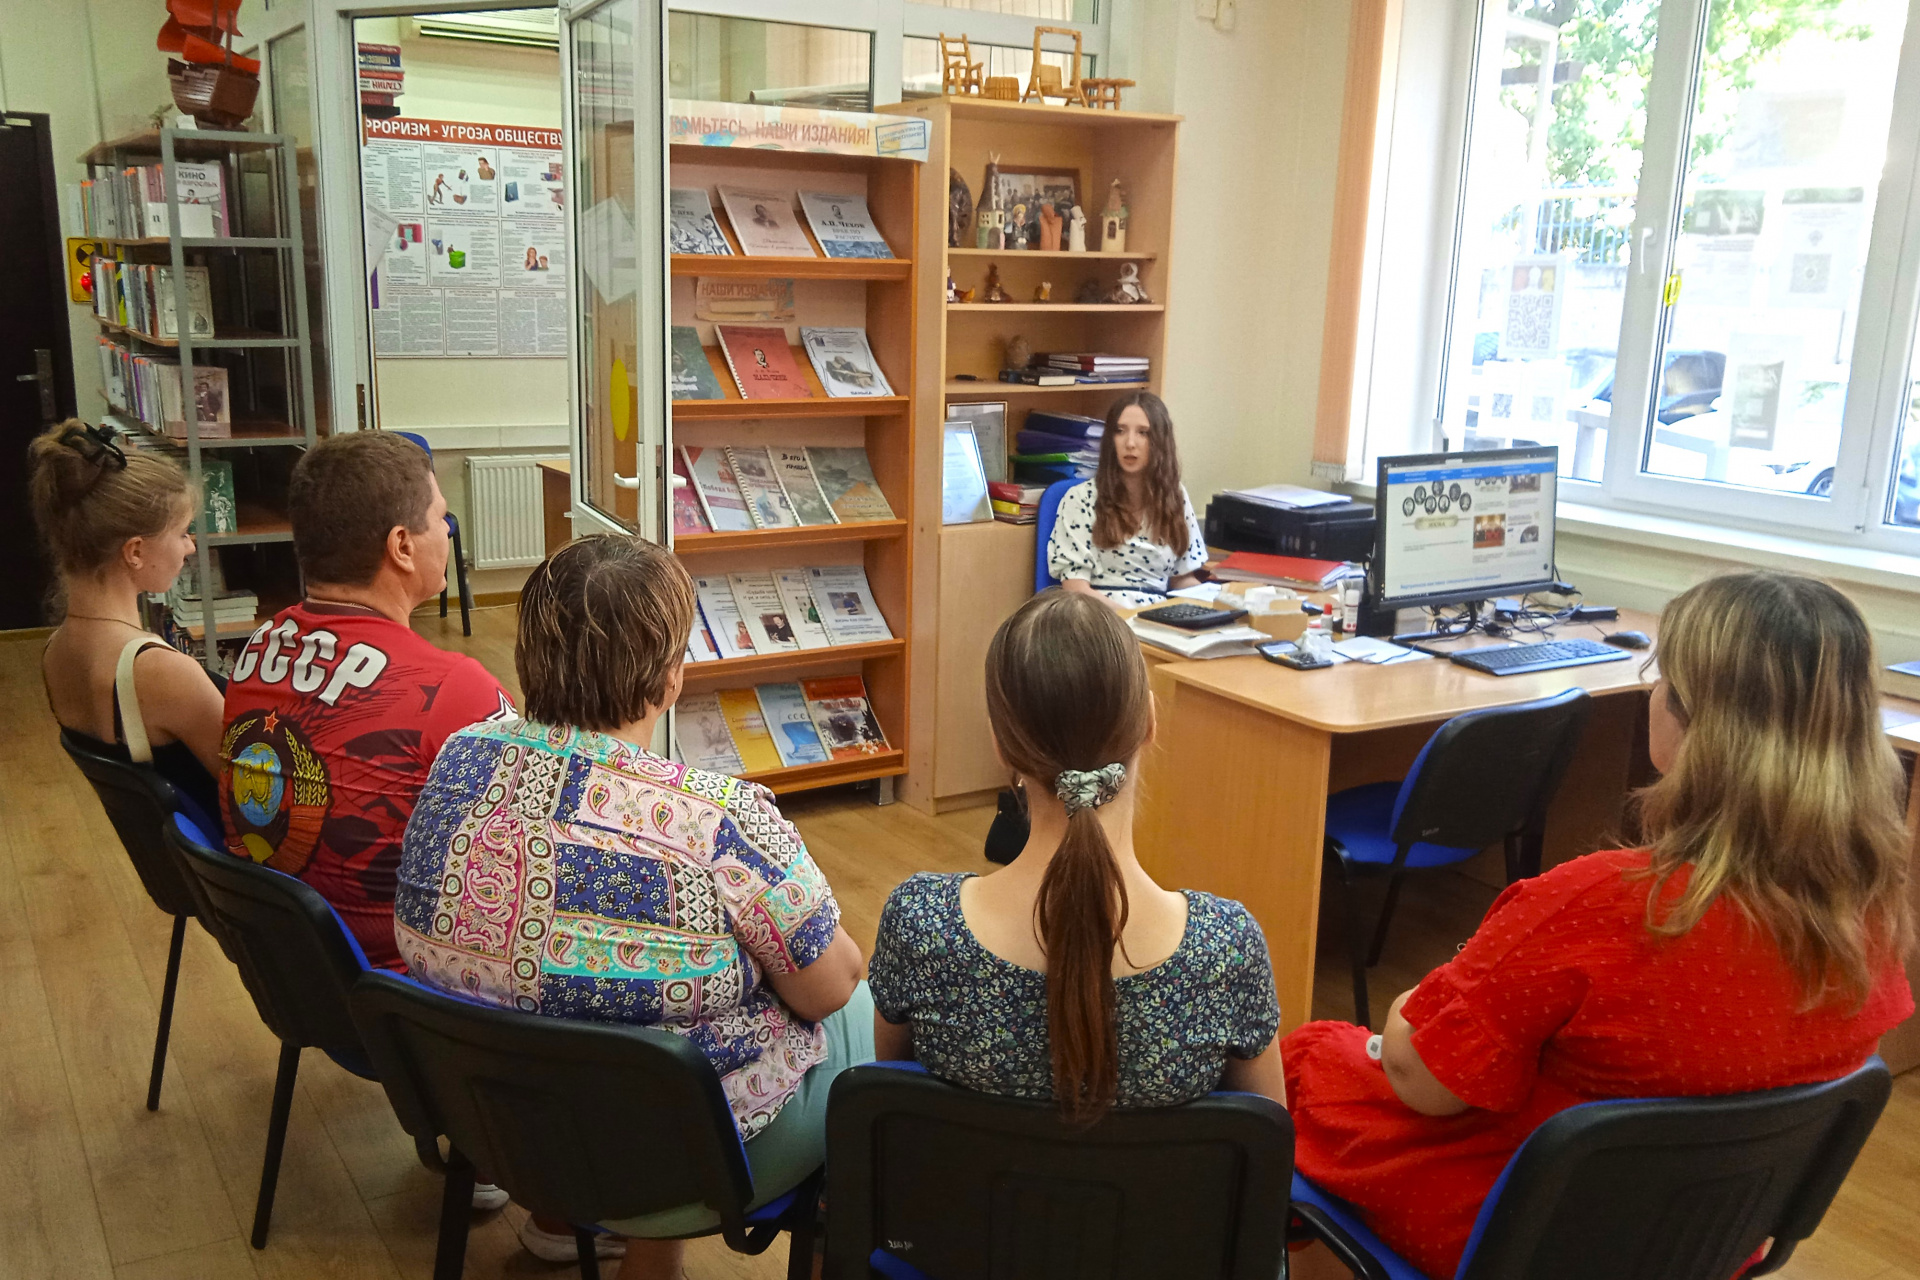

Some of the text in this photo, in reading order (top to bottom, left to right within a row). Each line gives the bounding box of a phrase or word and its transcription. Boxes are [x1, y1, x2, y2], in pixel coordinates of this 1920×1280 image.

[441, 124, 493, 142] УГРОЗА
[755, 120, 798, 140] НАШИ
[801, 123, 870, 146] ИЗДАНИЯ!
[178, 171, 206, 180] КИНО
[701, 282, 787, 299] НАШИ ИЗДАНИЯ
[232, 618, 388, 707] СССР
